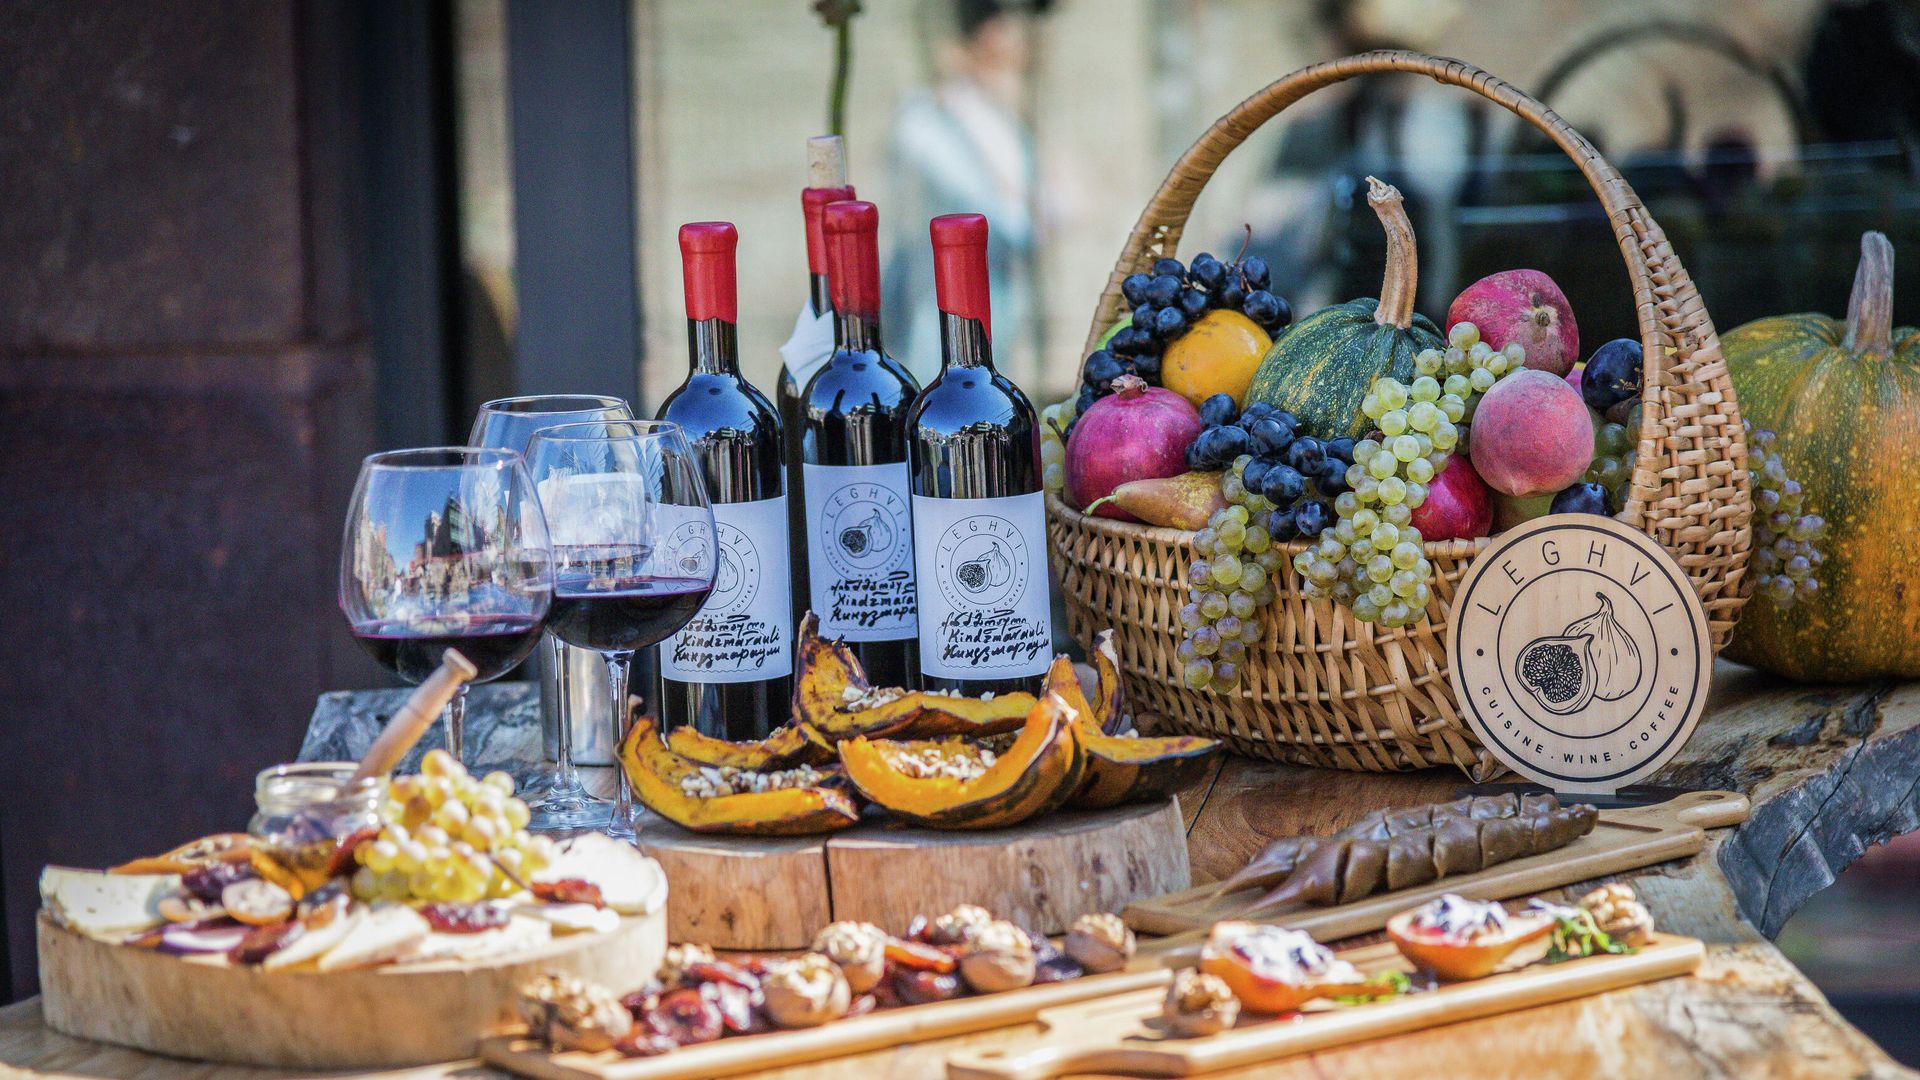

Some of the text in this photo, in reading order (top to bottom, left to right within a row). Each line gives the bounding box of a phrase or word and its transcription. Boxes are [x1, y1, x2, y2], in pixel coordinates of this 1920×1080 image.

[825, 487, 904, 519] LEGHVI
[942, 520, 1023, 552] LEGHVI
[1003, 578, 1024, 607] COFFEE
[1476, 540, 1674, 616] LEGHVI
[731, 583, 754, 612] COFFEE
[1482, 685, 1679, 764] CUISINE WINE COFFEE
